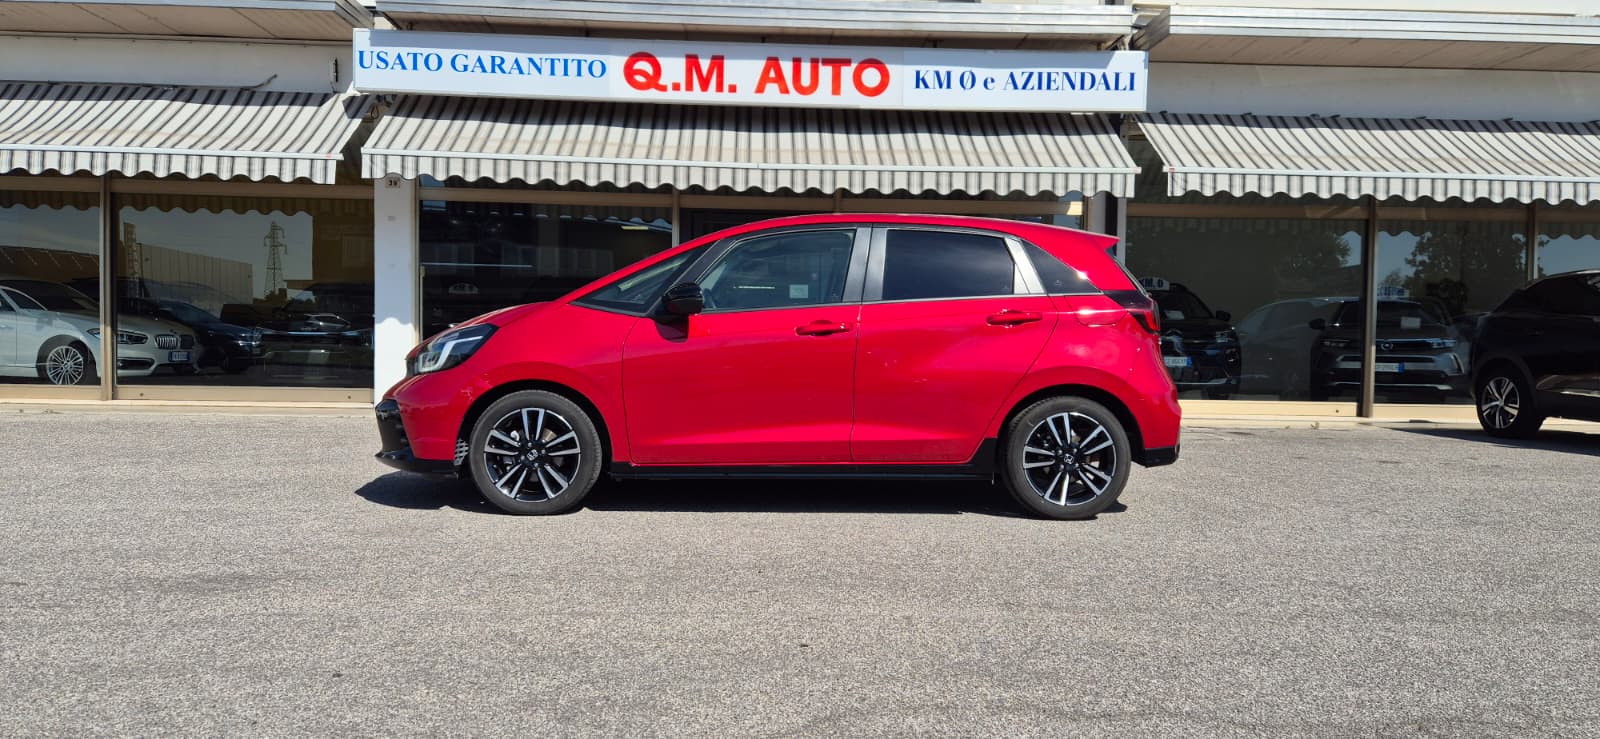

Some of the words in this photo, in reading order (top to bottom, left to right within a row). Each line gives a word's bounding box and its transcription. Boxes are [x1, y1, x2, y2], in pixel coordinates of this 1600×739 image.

[358, 50, 444, 72] USATO
[450, 53, 608, 78] GARANTITO
[623, 51, 738, 93] Q.M.
[755, 56, 891, 97] AUTO
[914, 69, 952, 90] KM
[983, 76, 996, 91] e
[1004, 71, 1137, 92] AZIENDALI
